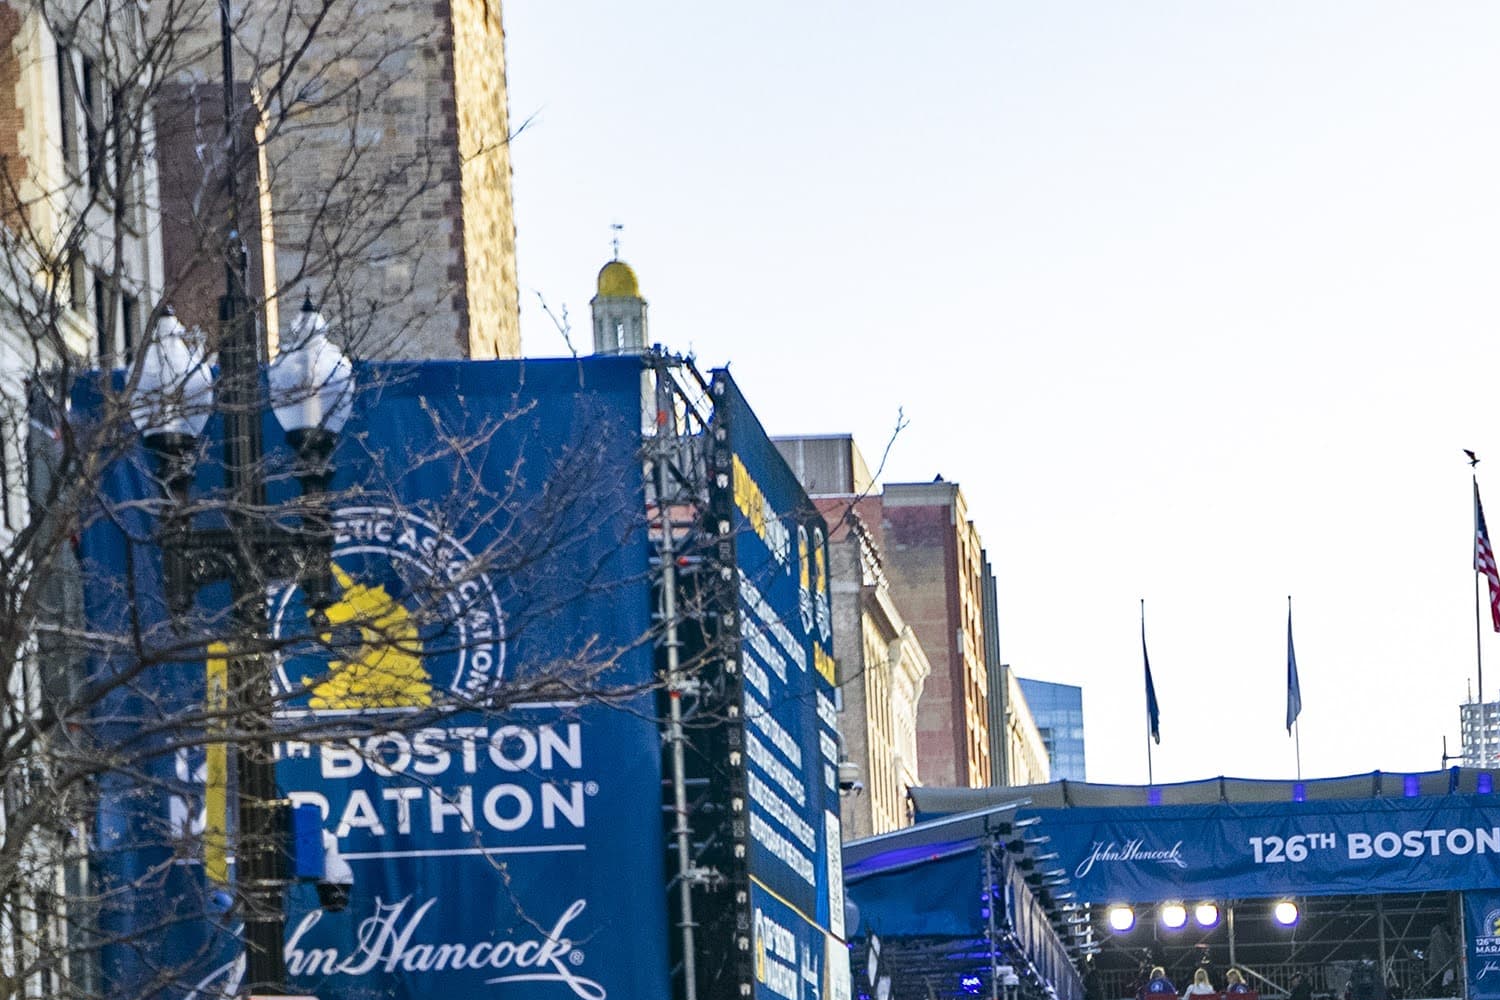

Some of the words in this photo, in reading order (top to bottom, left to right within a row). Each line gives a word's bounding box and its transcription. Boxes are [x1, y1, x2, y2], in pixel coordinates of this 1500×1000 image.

[319, 723, 582, 778] BOSTON
[1075, 841, 1123, 878] John
[1120, 839, 1185, 868] Hancock
[1249, 832, 1337, 863] 126TH
